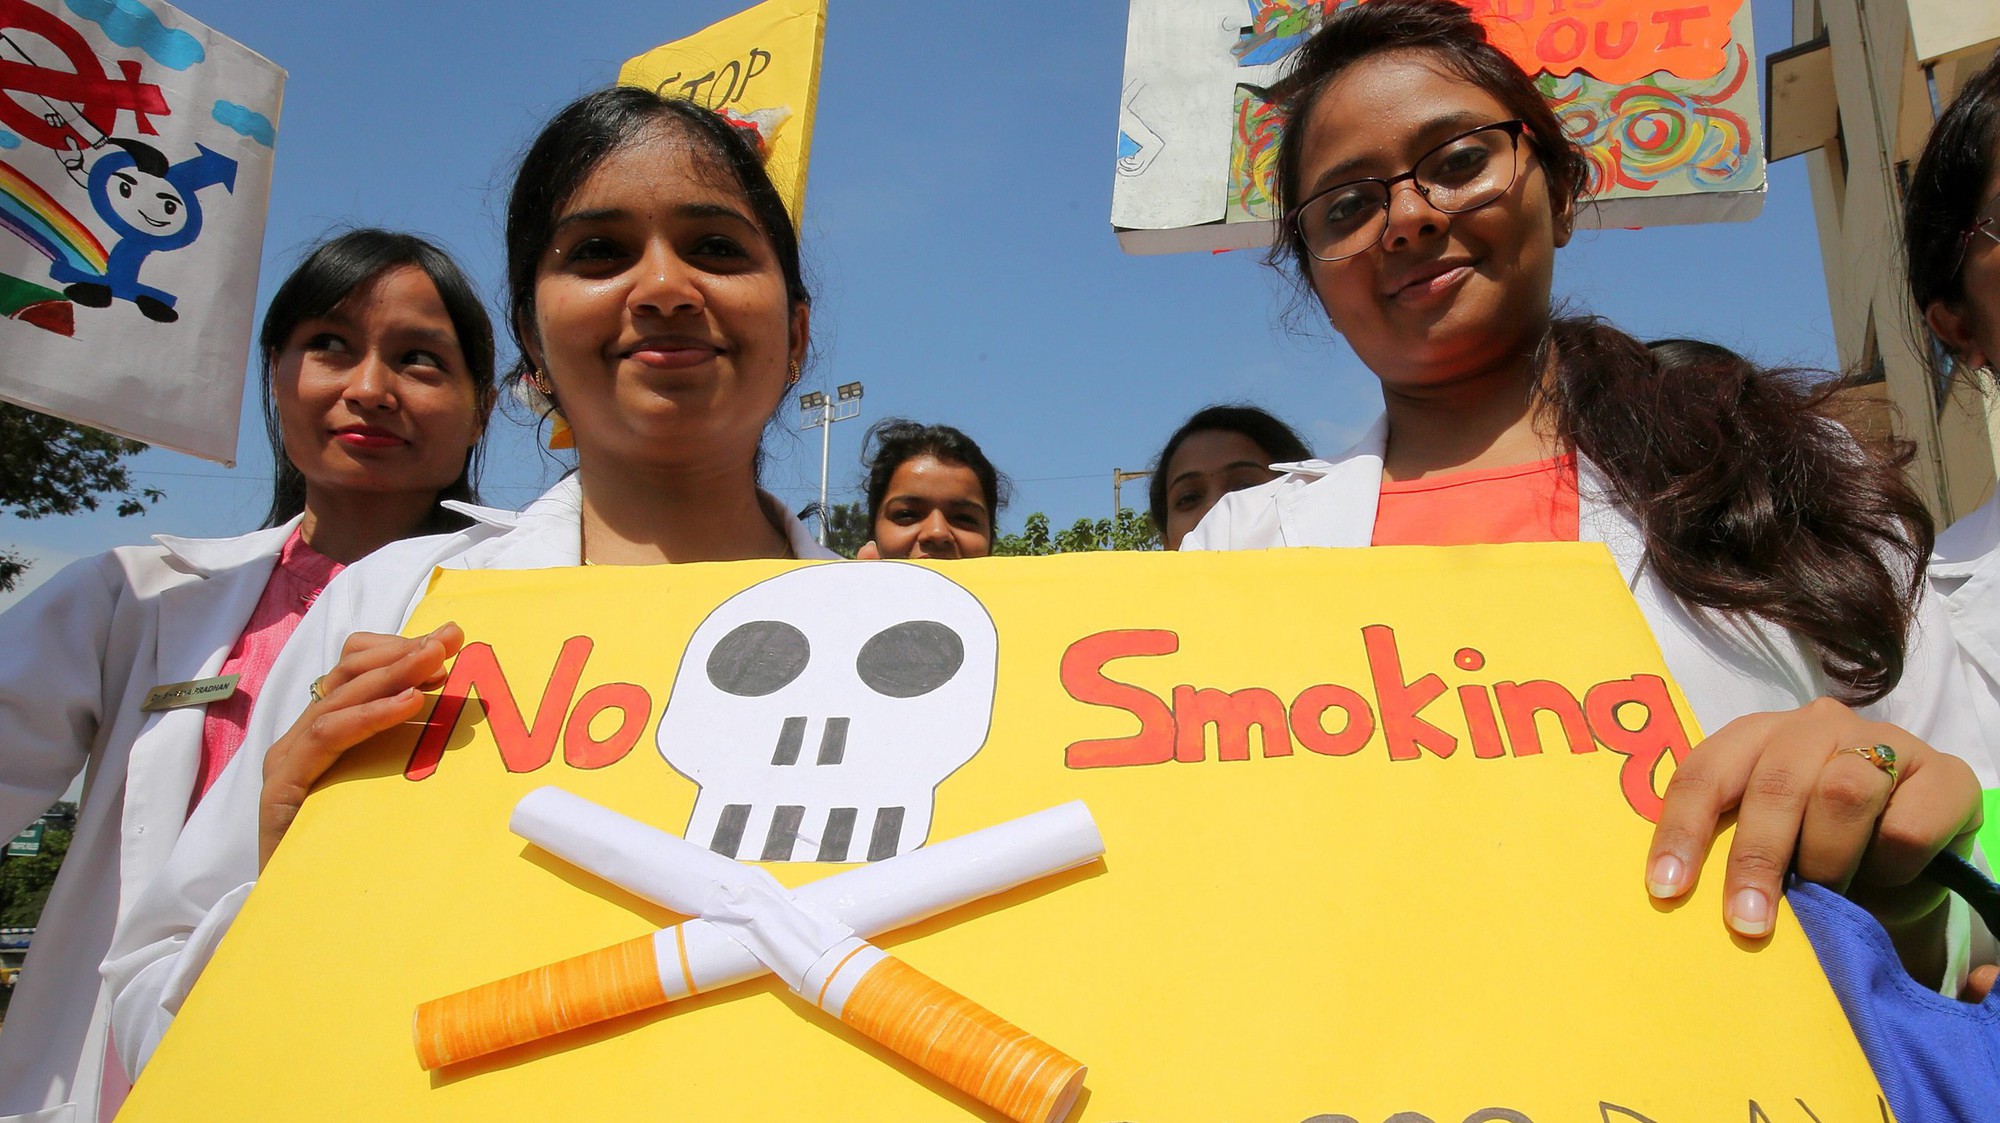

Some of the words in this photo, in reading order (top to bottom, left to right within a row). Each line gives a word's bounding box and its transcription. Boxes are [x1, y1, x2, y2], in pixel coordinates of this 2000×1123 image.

[1536, 6, 1710, 63] OUT
[193, 682, 230, 695] PRADHAN
[404, 635, 652, 781] No
[1060, 624, 1692, 824] Smoking
